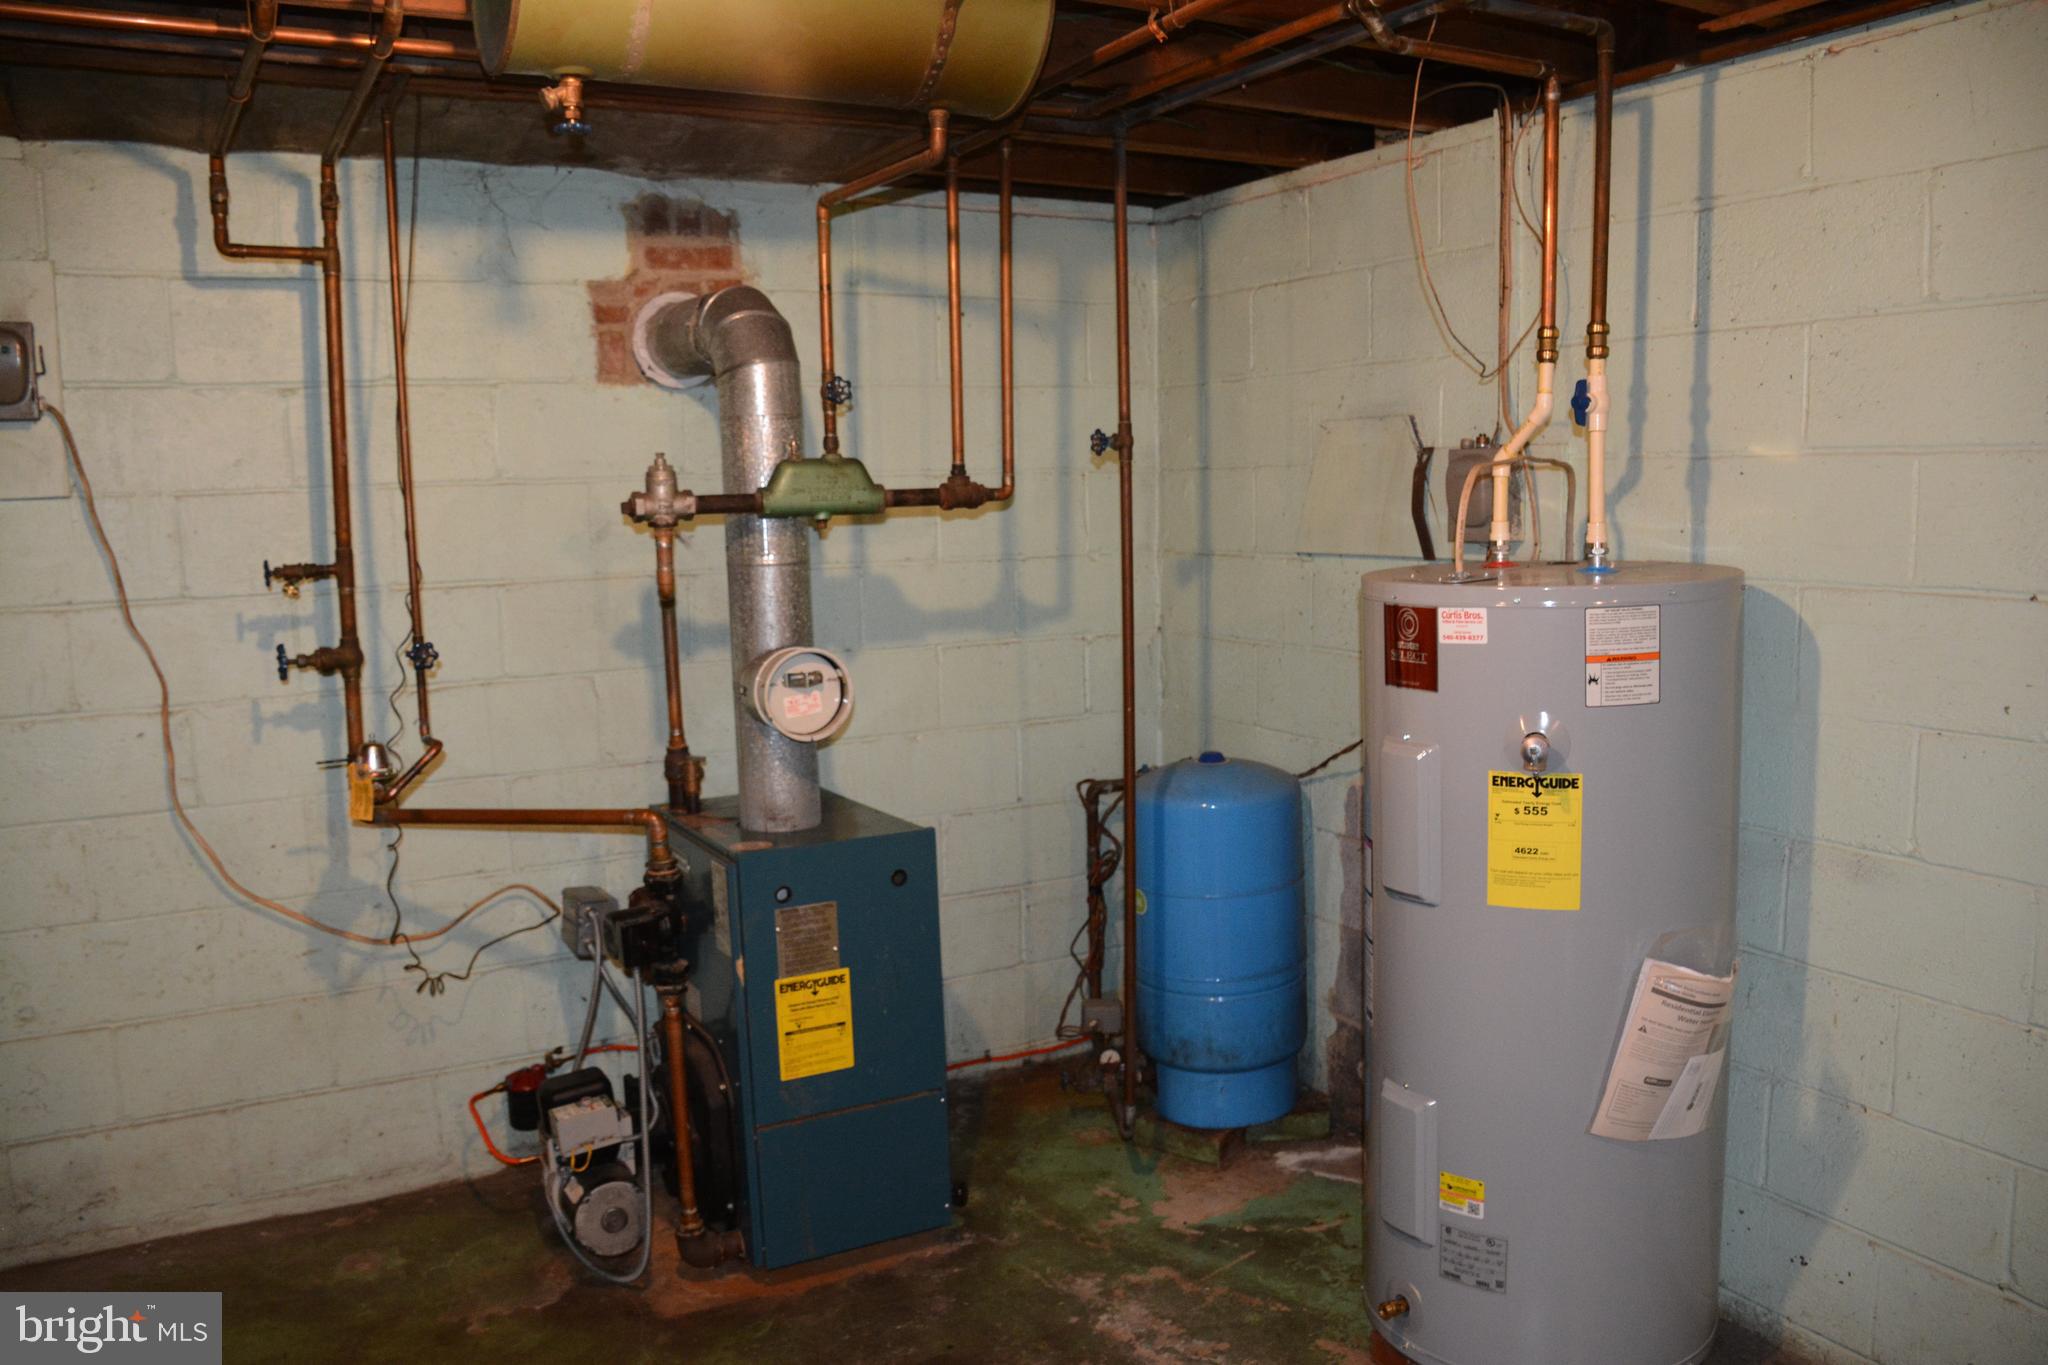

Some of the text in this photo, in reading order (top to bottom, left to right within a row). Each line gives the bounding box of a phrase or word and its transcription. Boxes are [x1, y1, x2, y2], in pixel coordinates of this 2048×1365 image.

[1441, 610, 1484, 619] Curtis Bros.
[1492, 775, 1580, 792] ENERGYGUIDE
[1523, 806, 1548, 816] 555
[1514, 846, 1539, 855] 4622
